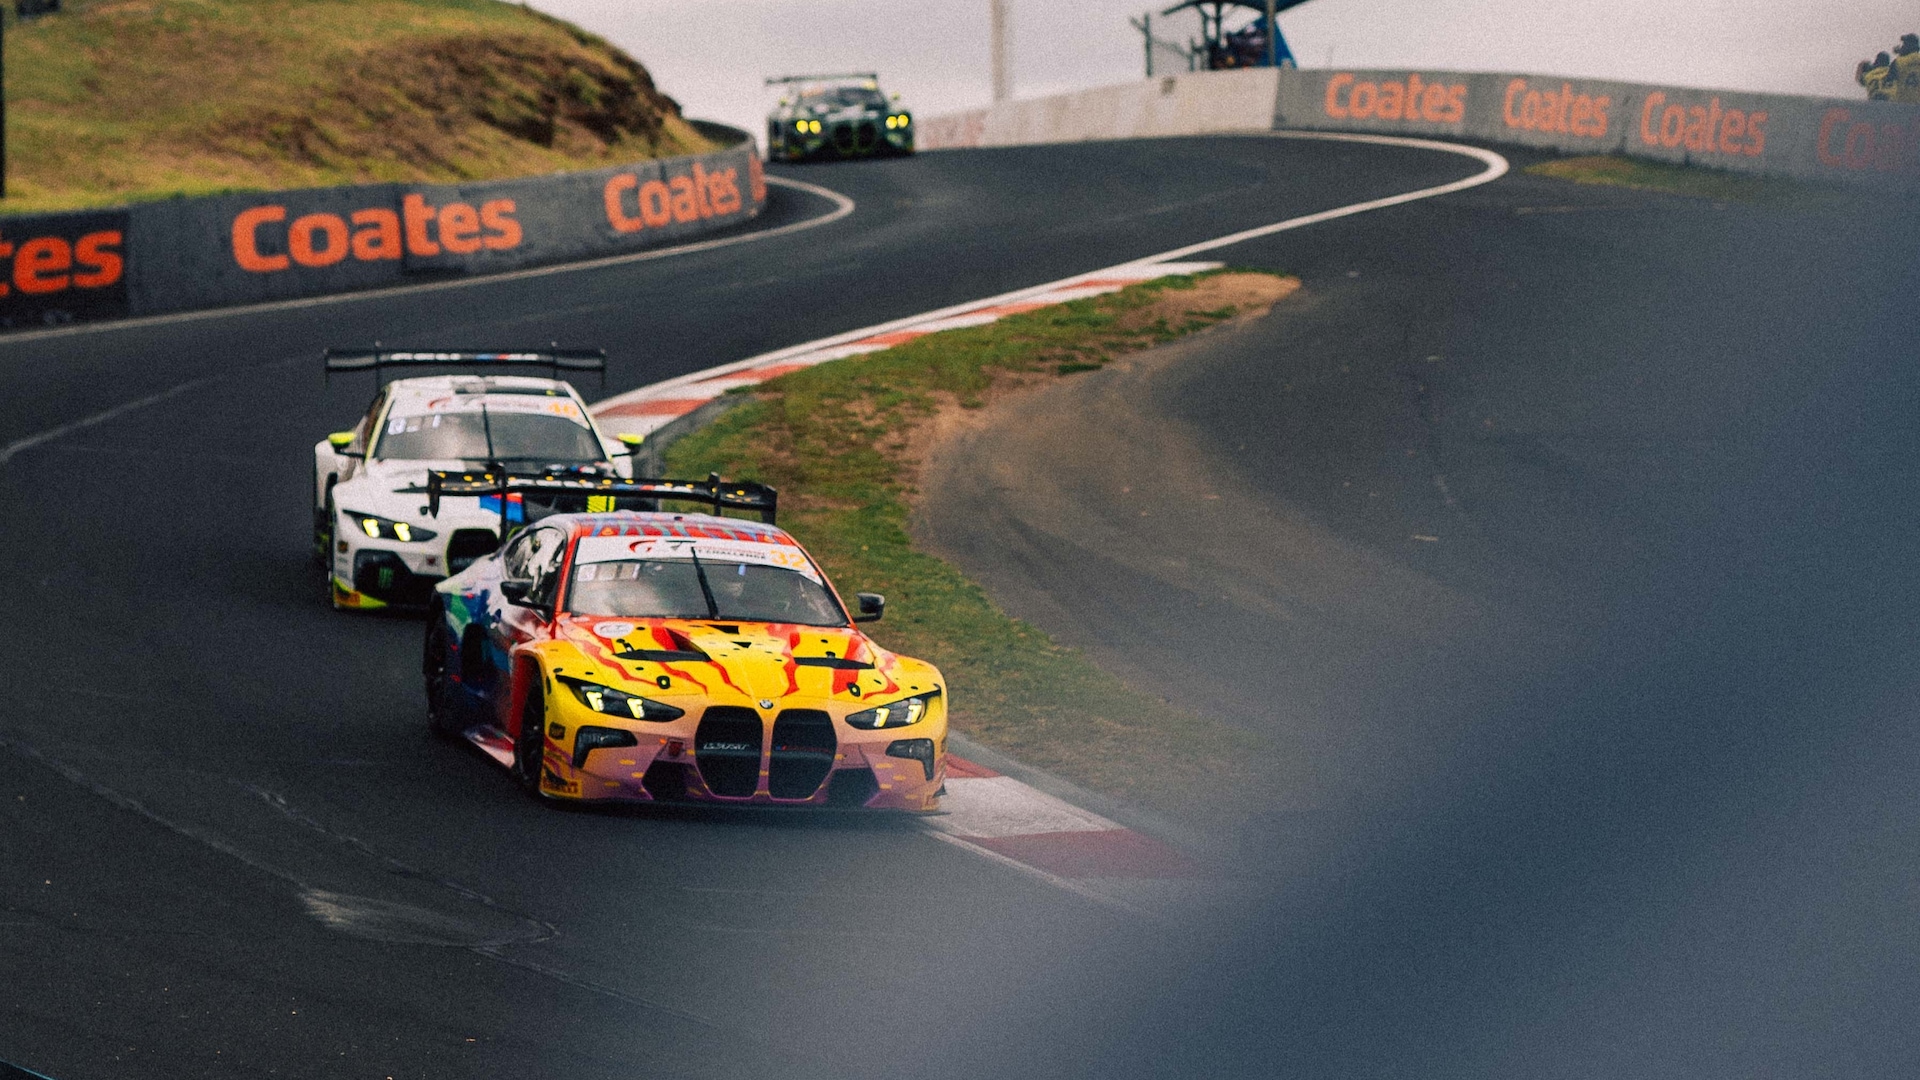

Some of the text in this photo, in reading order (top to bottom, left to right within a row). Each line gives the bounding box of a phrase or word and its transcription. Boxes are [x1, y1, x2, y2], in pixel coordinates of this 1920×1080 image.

[1324, 72, 1467, 124] Coates
[1502, 78, 1611, 138] Coates
[1640, 92, 1767, 156] Coates
[605, 161, 741, 232] Coates
[232, 194, 522, 272] Coates
[770, 550, 807, 570] 32
